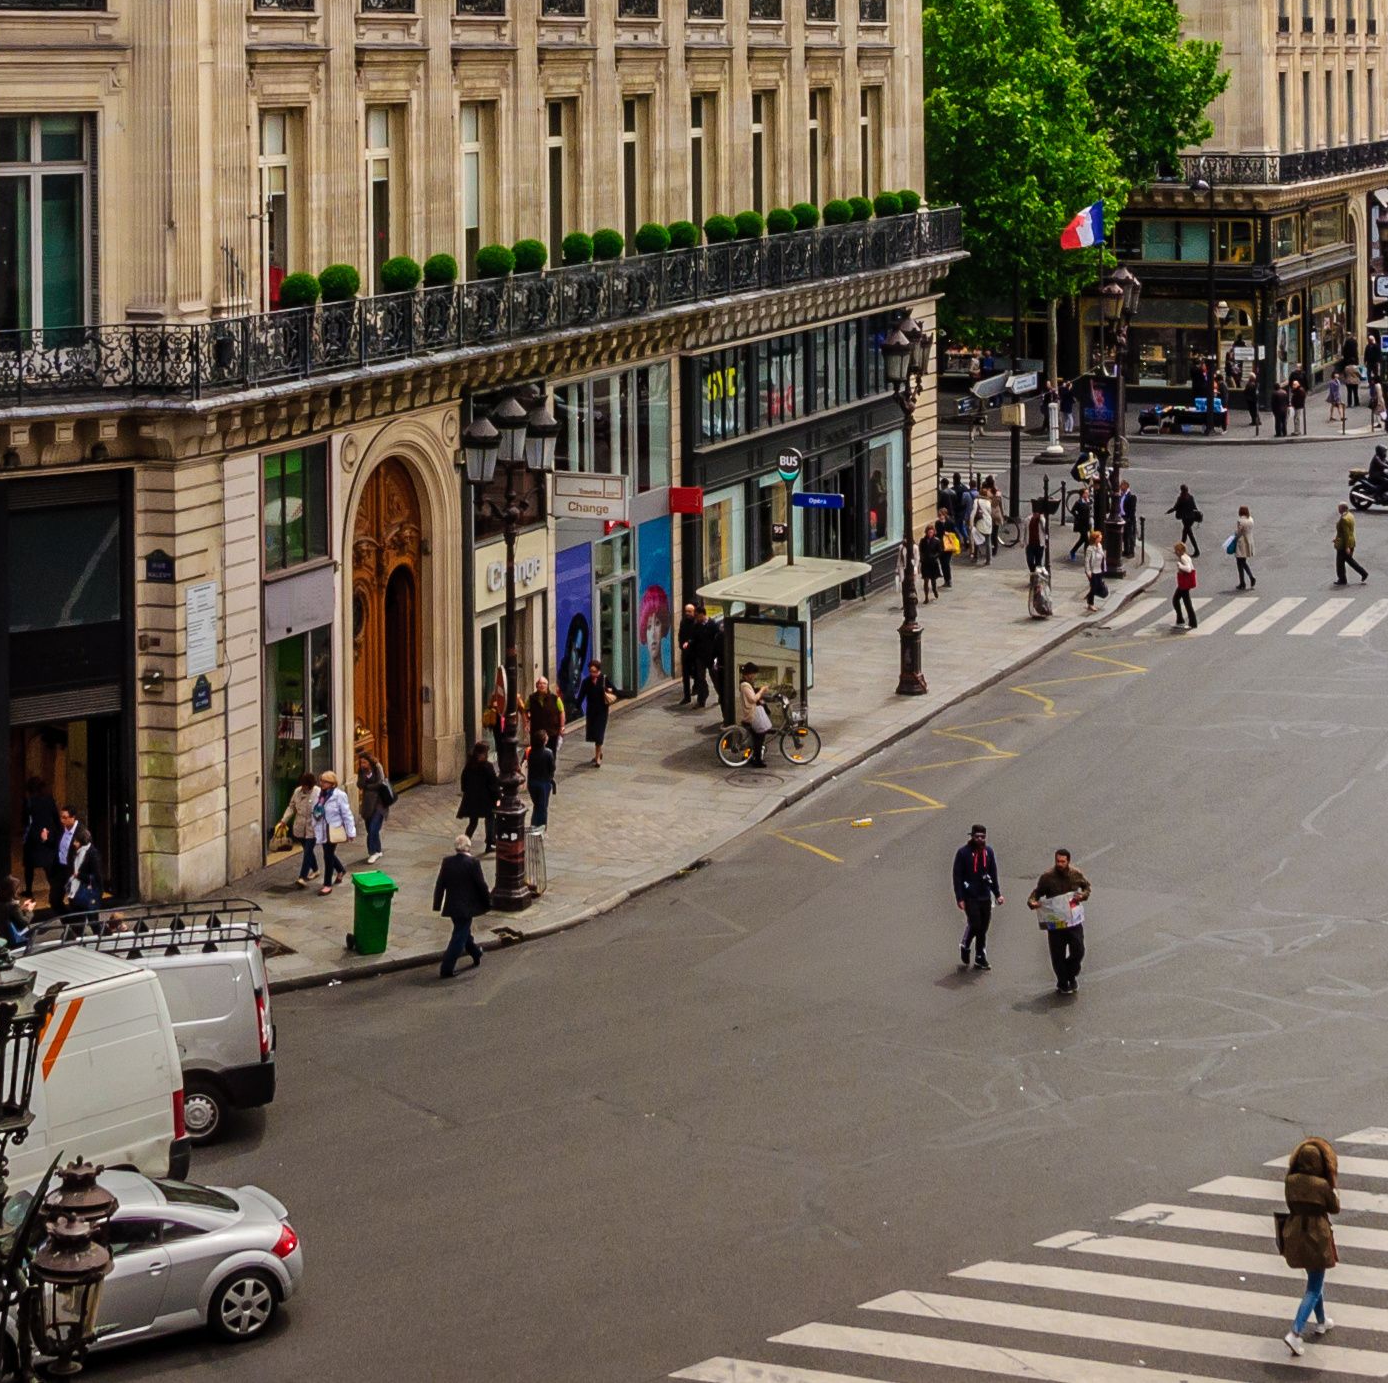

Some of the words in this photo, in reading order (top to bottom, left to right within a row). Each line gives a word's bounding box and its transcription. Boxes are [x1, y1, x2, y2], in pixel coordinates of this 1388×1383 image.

[779, 455, 799, 467] BUS
[568, 501, 609, 515] Change
[773, 526, 783, 534] 95
